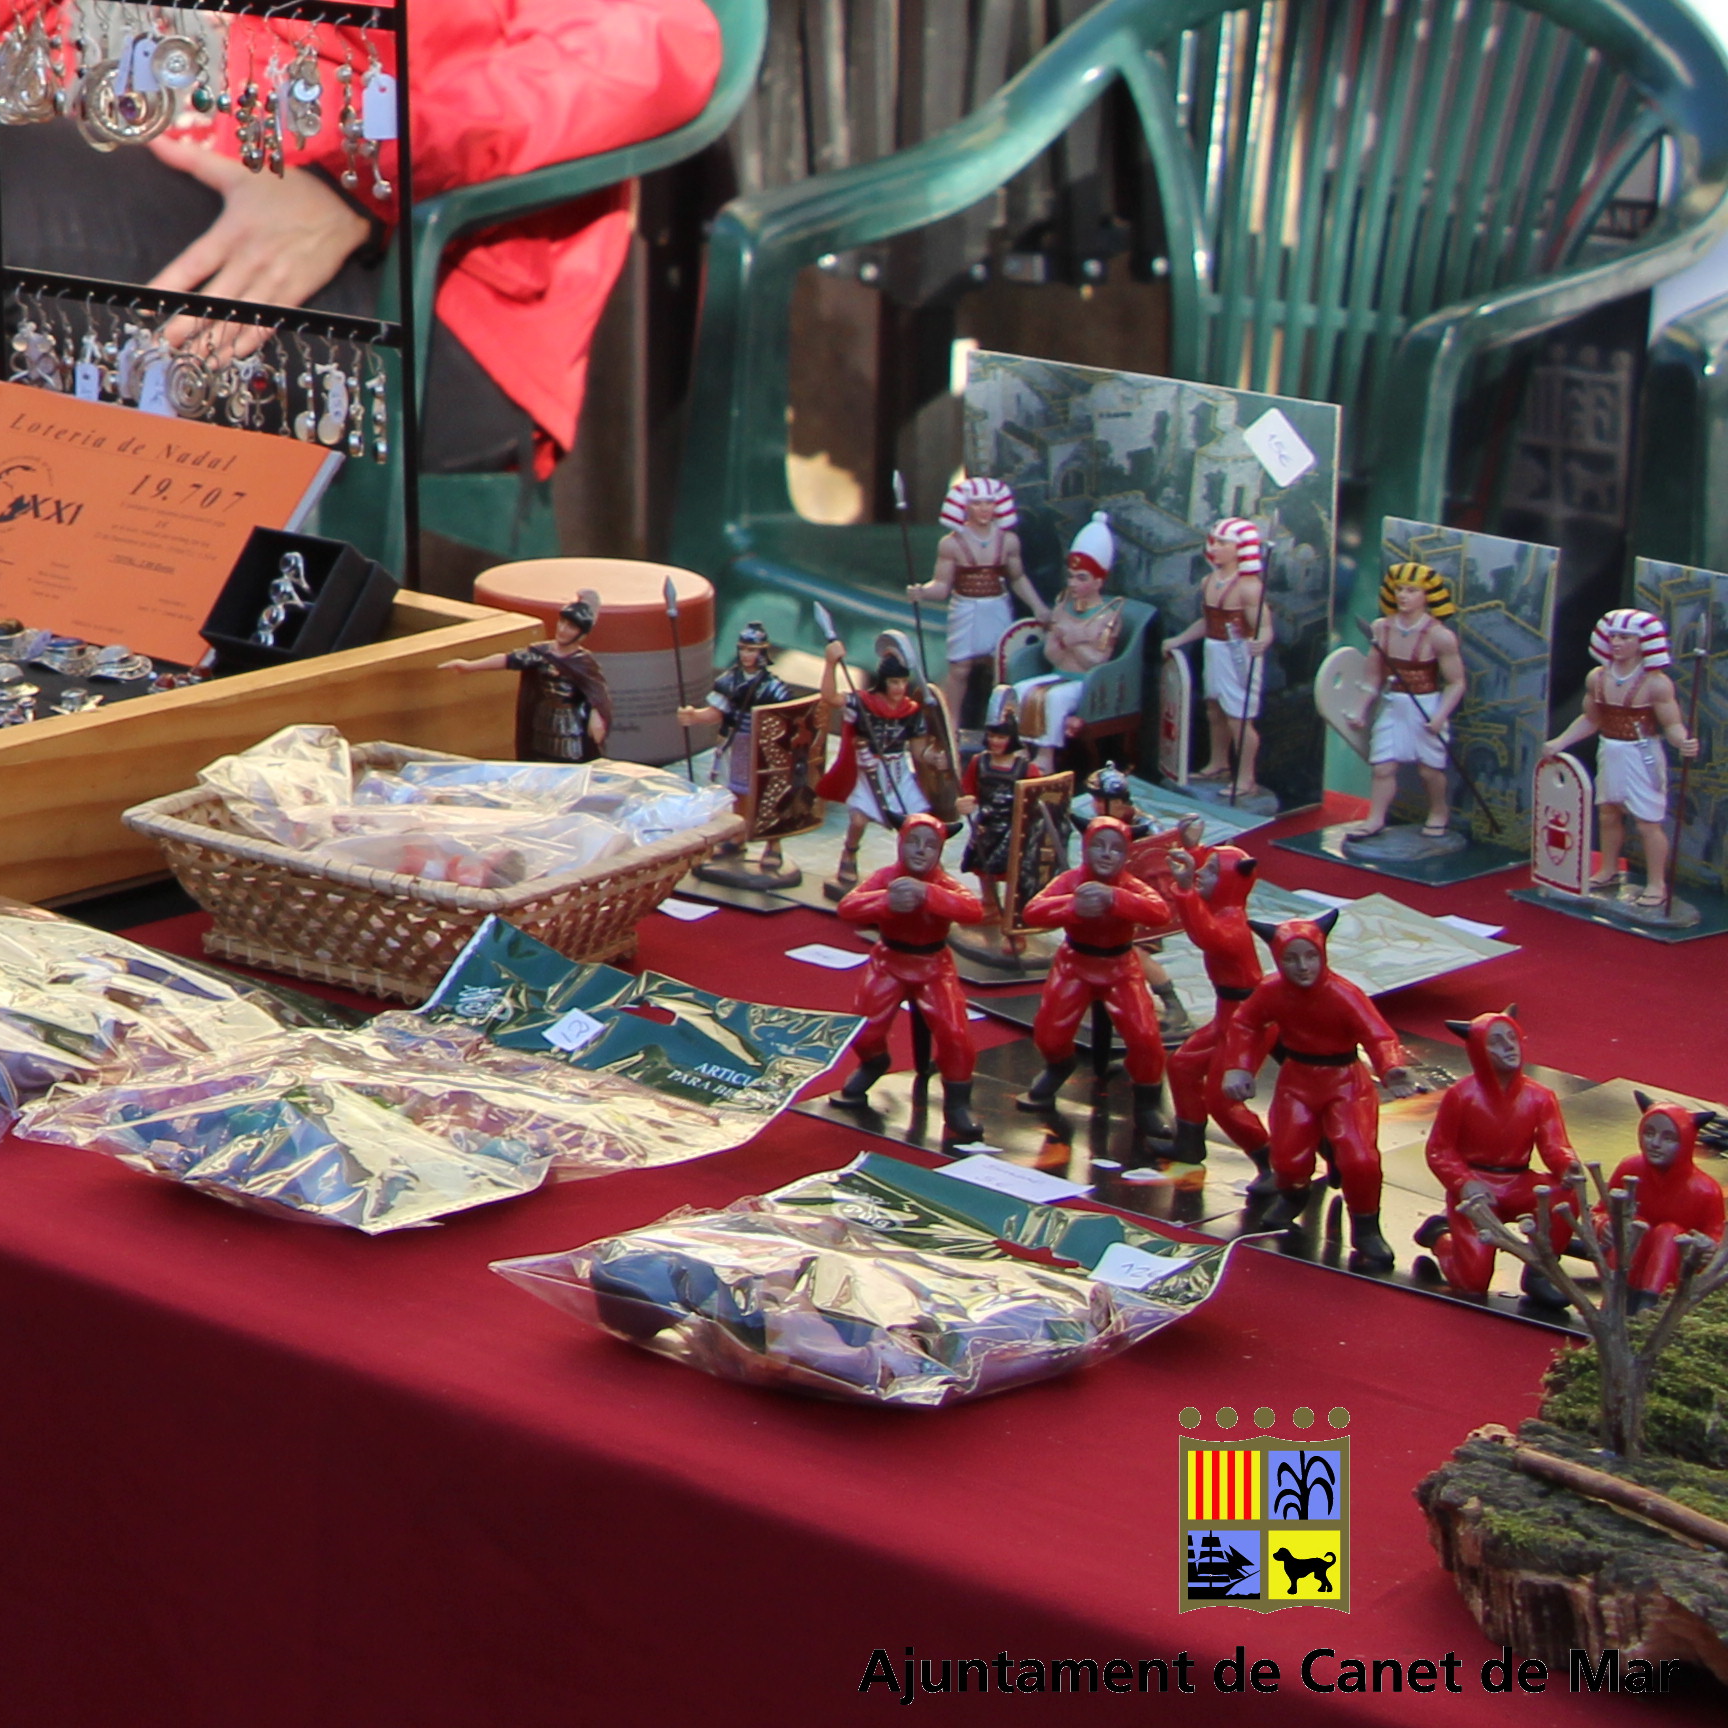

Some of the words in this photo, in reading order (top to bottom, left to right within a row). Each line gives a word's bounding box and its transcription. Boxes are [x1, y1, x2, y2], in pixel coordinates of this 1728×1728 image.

[8, 413, 105, 449] Loteria
[117, 435, 146, 454] de
[156, 442, 237, 471] Nadal
[130, 474, 247, 513] 19.707
[667, 1069, 710, 1091] PARA
[695, 1062, 756, 1087] ARTICU
